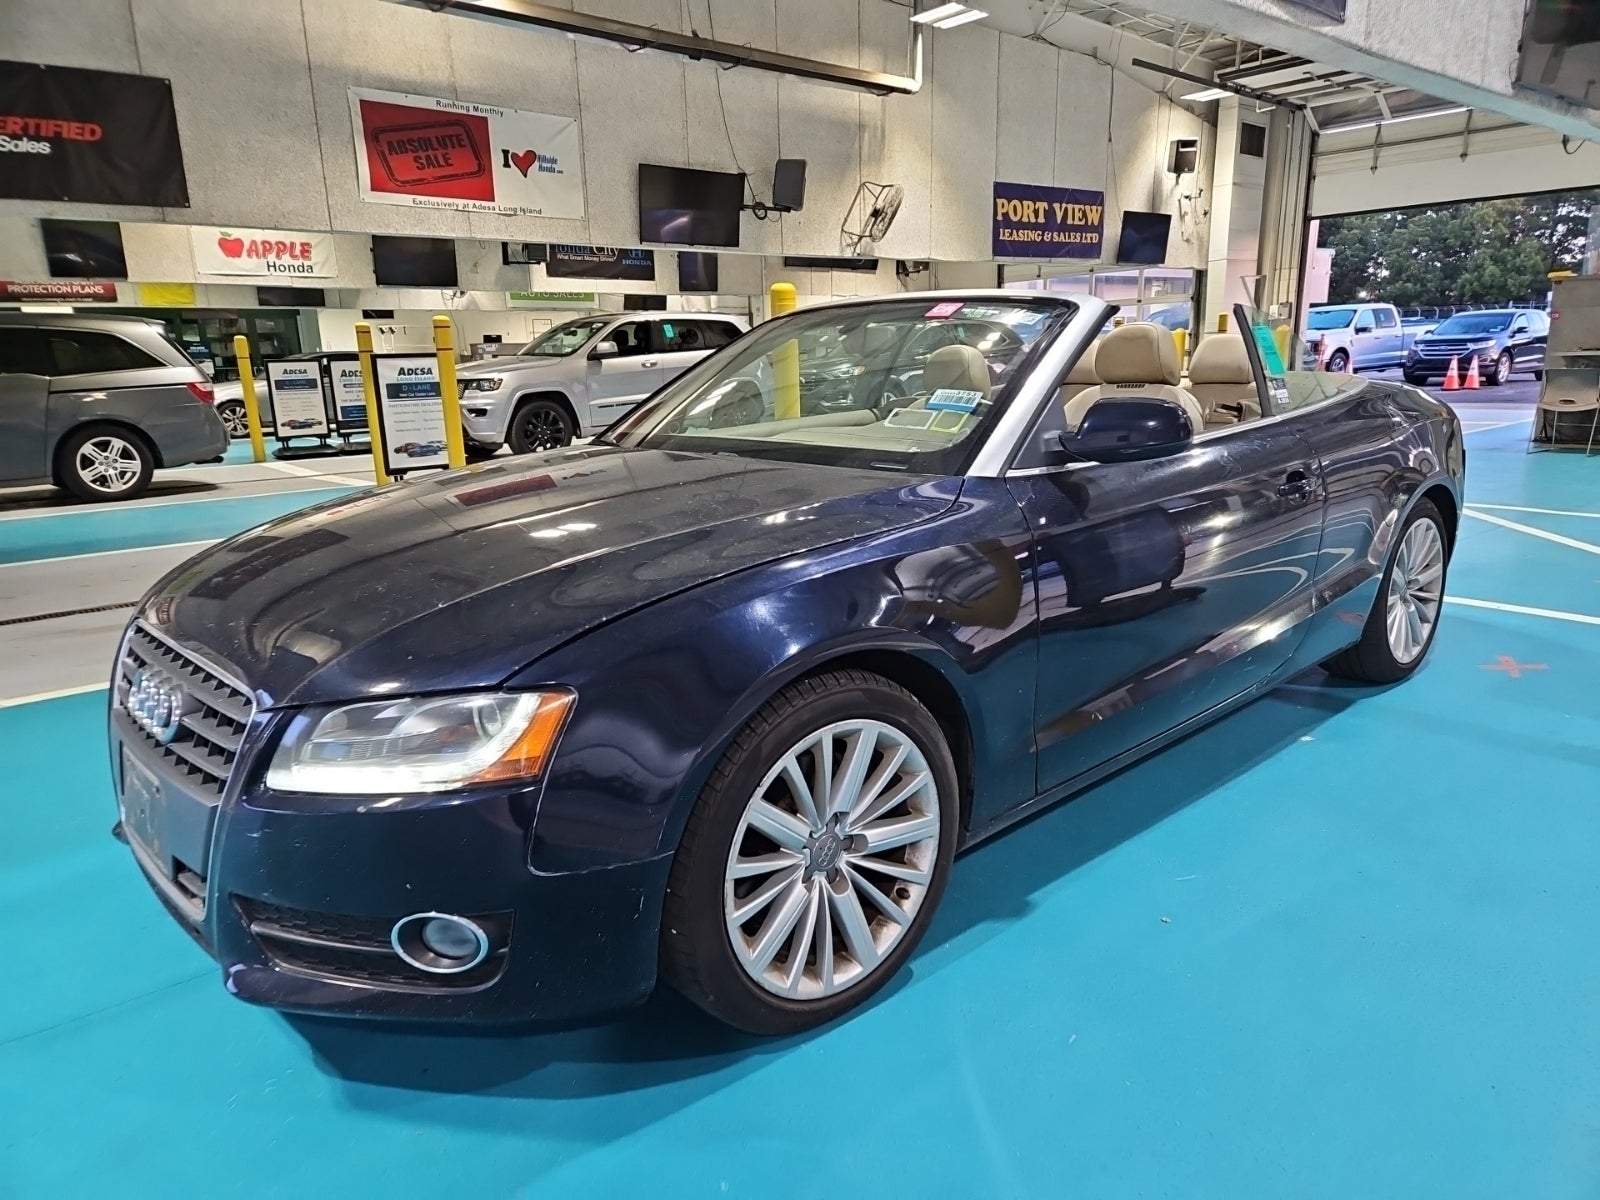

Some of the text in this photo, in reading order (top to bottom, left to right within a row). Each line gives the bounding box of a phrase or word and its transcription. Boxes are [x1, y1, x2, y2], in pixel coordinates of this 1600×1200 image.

[436, 100, 503, 117] Running Monthly
[0, 116, 102, 141] ERTIFIED
[0, 135, 51, 154] Sales
[387, 134, 466, 156] ABSOLUTE
[413, 152, 454, 171] SALE
[501, 149, 511, 168] I
[413, 198, 459, 209] Exclusively
[472, 203, 496, 211] Adesa
[498, 205, 517, 214] Long
[520, 206, 542, 215] Island
[996, 199, 1102, 226] PORT VIEW
[999, 229, 1099, 243] LEASING & SALES LTD
[247, 240, 312, 261] APPLE
[267, 261, 314, 273] Honda
[7, 284, 104, 294] PROTECTION PLANS
[340, 369, 363, 378] ADES
[397, 367, 433, 376] ADESA
